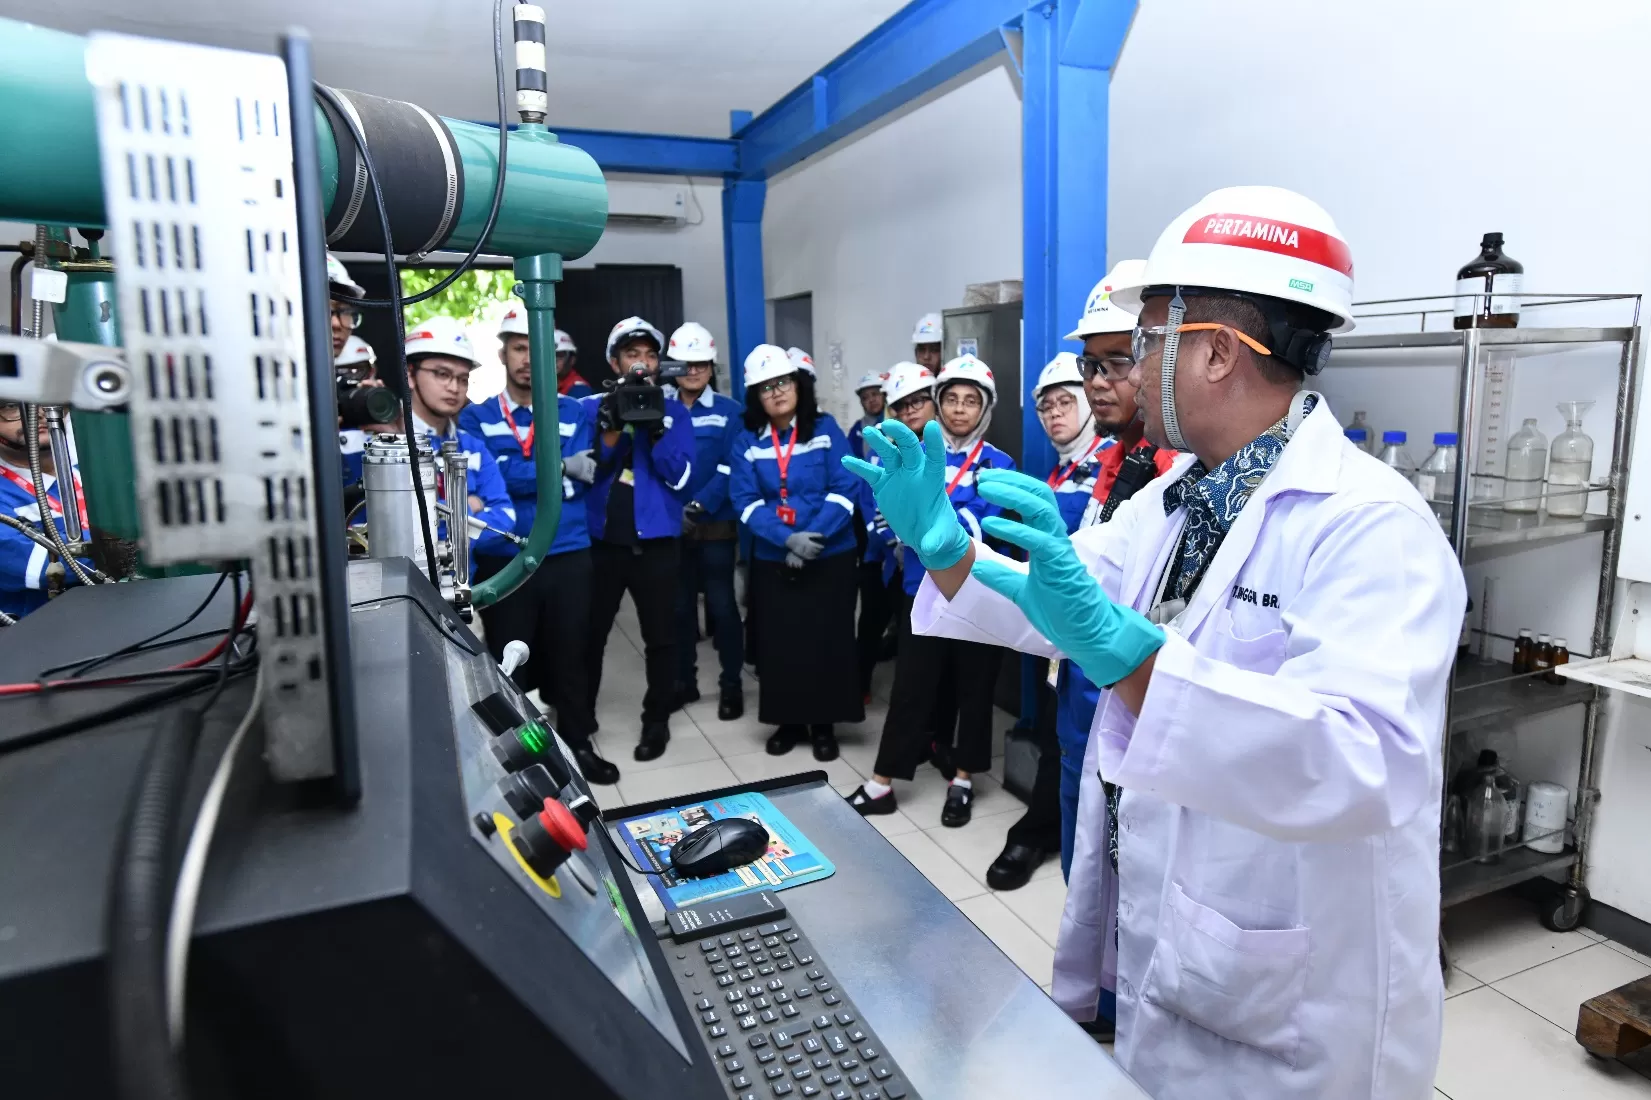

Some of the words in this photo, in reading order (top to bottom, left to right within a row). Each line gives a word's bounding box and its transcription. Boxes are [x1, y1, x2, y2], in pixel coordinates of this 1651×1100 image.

[1204, 218, 1299, 248] PERTAMINA
[1290, 280, 1312, 291] MSA
[1262, 594, 1280, 608] BR
